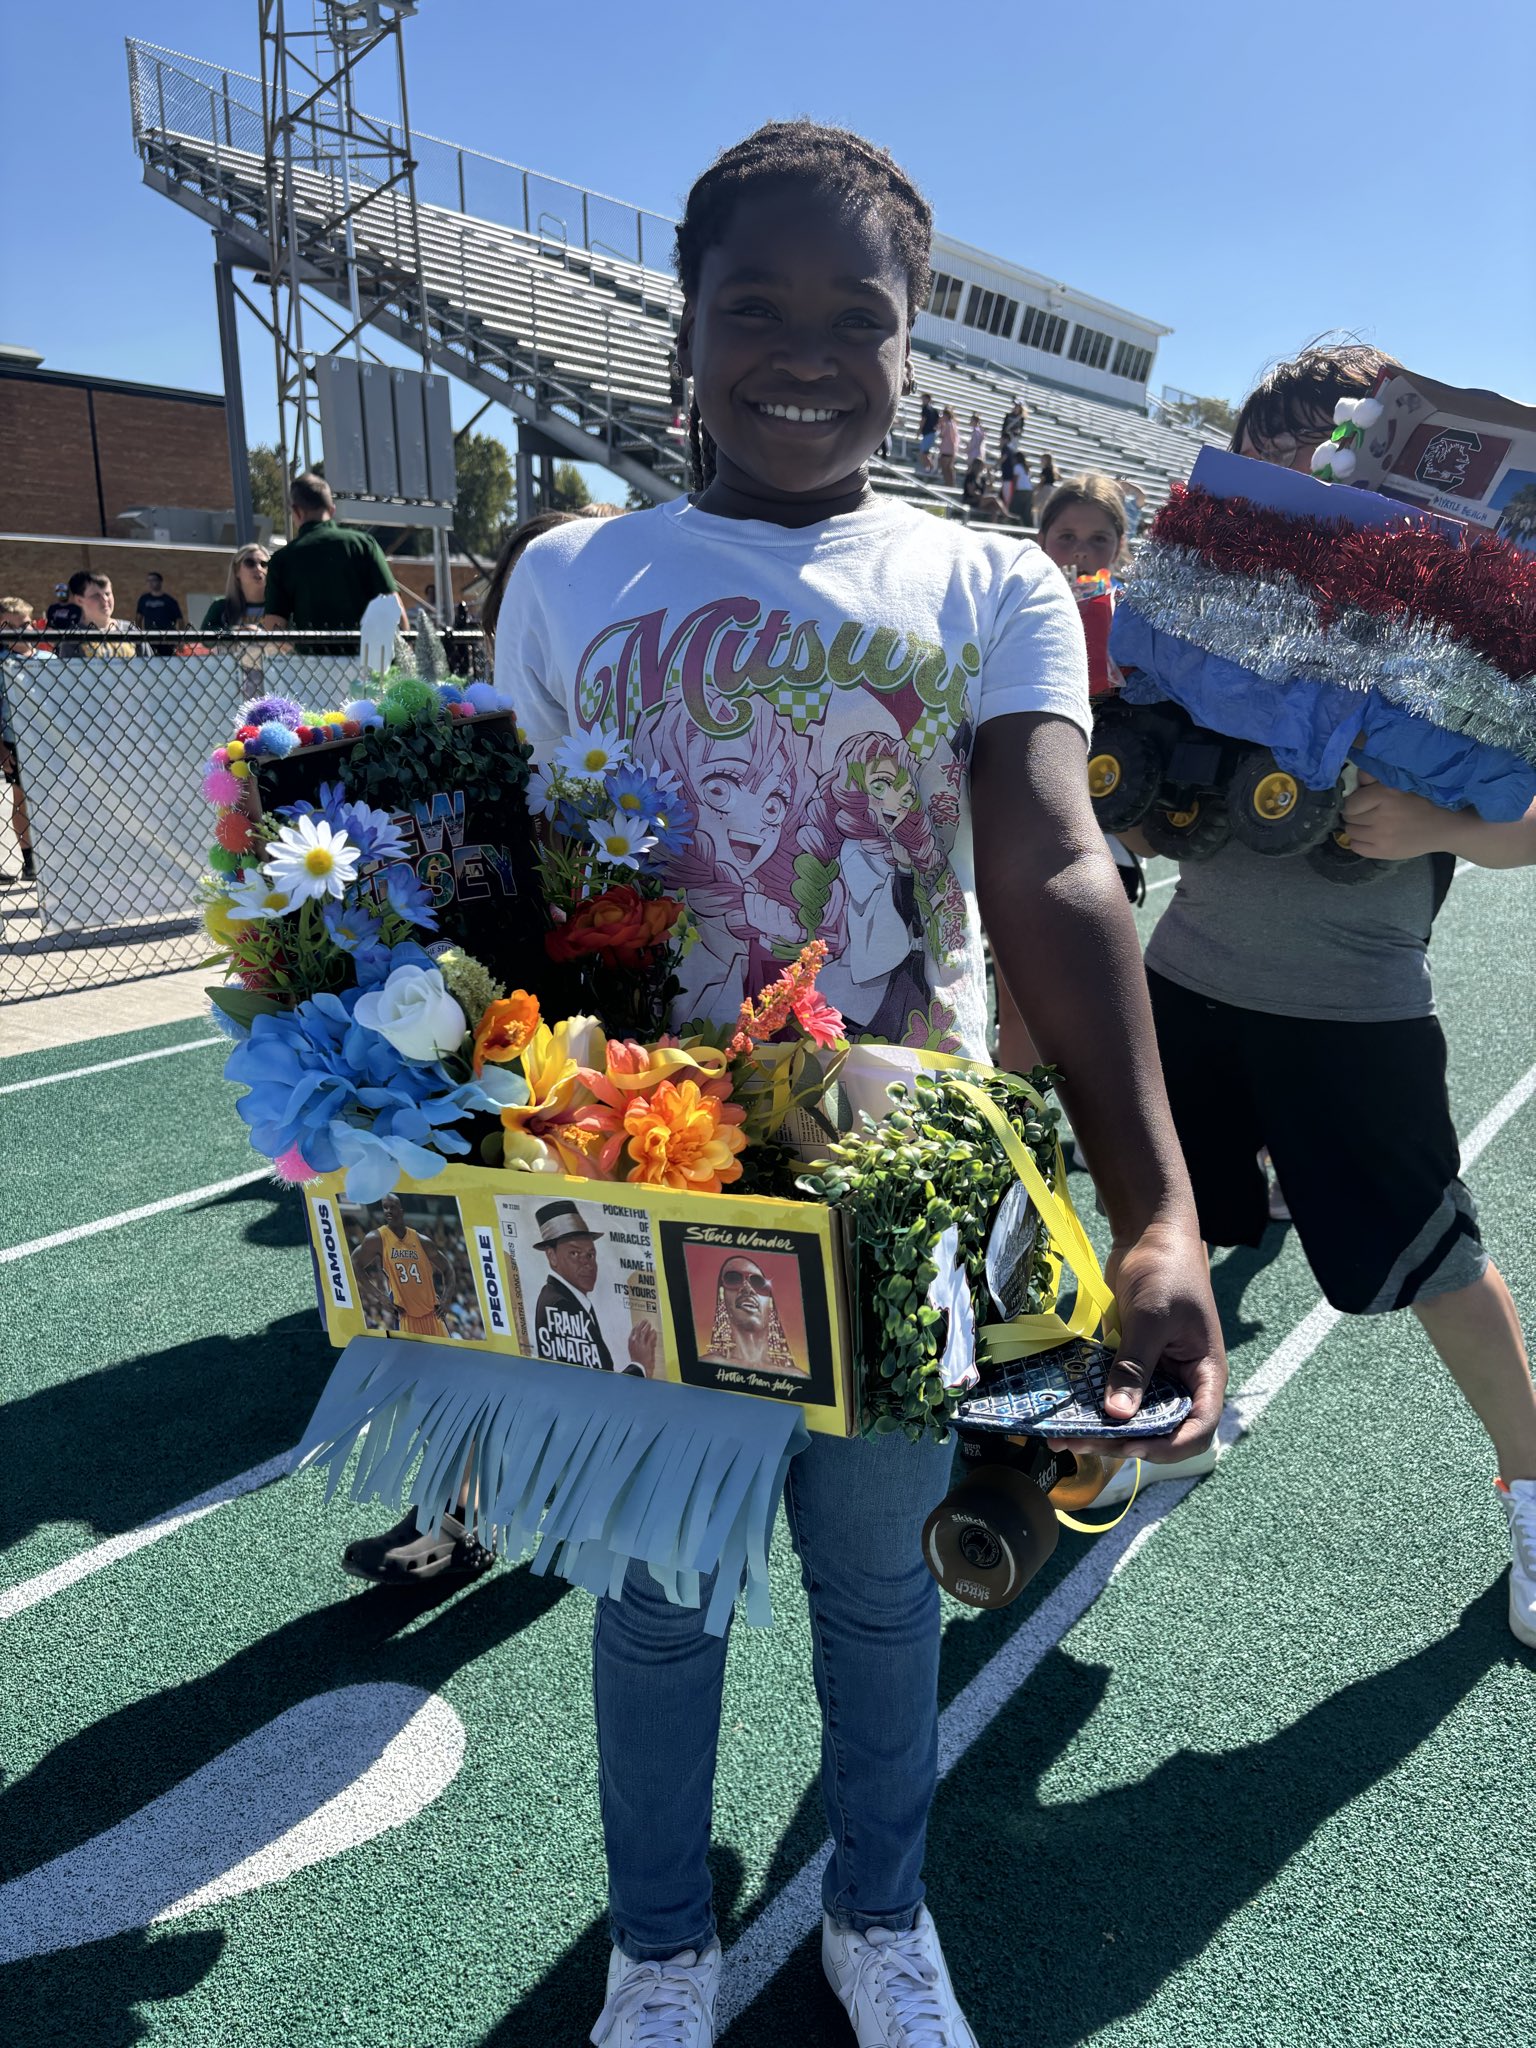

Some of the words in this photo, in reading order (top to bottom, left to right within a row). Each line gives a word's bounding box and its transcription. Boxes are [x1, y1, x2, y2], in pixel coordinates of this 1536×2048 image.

[1433, 495, 1460, 511] MYRTLE
[1461, 506, 1488, 521] BEACH
[574, 596, 981, 740] Mitsuri
[382, 790, 466, 867] EW
[602, 1203, 648, 1220] POCKETFUL
[507, 1223, 513, 1235] 5
[638, 1221, 650, 1233] OF
[609, 1230, 651, 1247] MIRACLES
[683, 1226, 733, 1245] Stevie
[736, 1231, 795, 1251] Wonder
[318, 1203, 346, 1302] FAMOUS
[391, 1247, 418, 1260] LAKERS
[395, 1262, 422, 1284] 34
[619, 1258, 645, 1272] NAME
[645, 1262, 654, 1273] IT
[479, 1234, 504, 1328] PEOPLE
[513, 1273, 523, 1299] SONG
[638, 1273, 655, 1286] AND
[613, 1282, 630, 1296] IT'S
[630, 1285, 657, 1300] YOURS
[517, 1301, 528, 1336] SINATRA
[544, 1306, 593, 1342] FRANK
[538, 1326, 603, 1369] SINATRA
[715, 1367, 747, 1385] Hotter
[746, 1374, 771, 1389] Than
[951, 1513, 989, 1530] skitch
[955, 1581, 990, 1601] skitch
